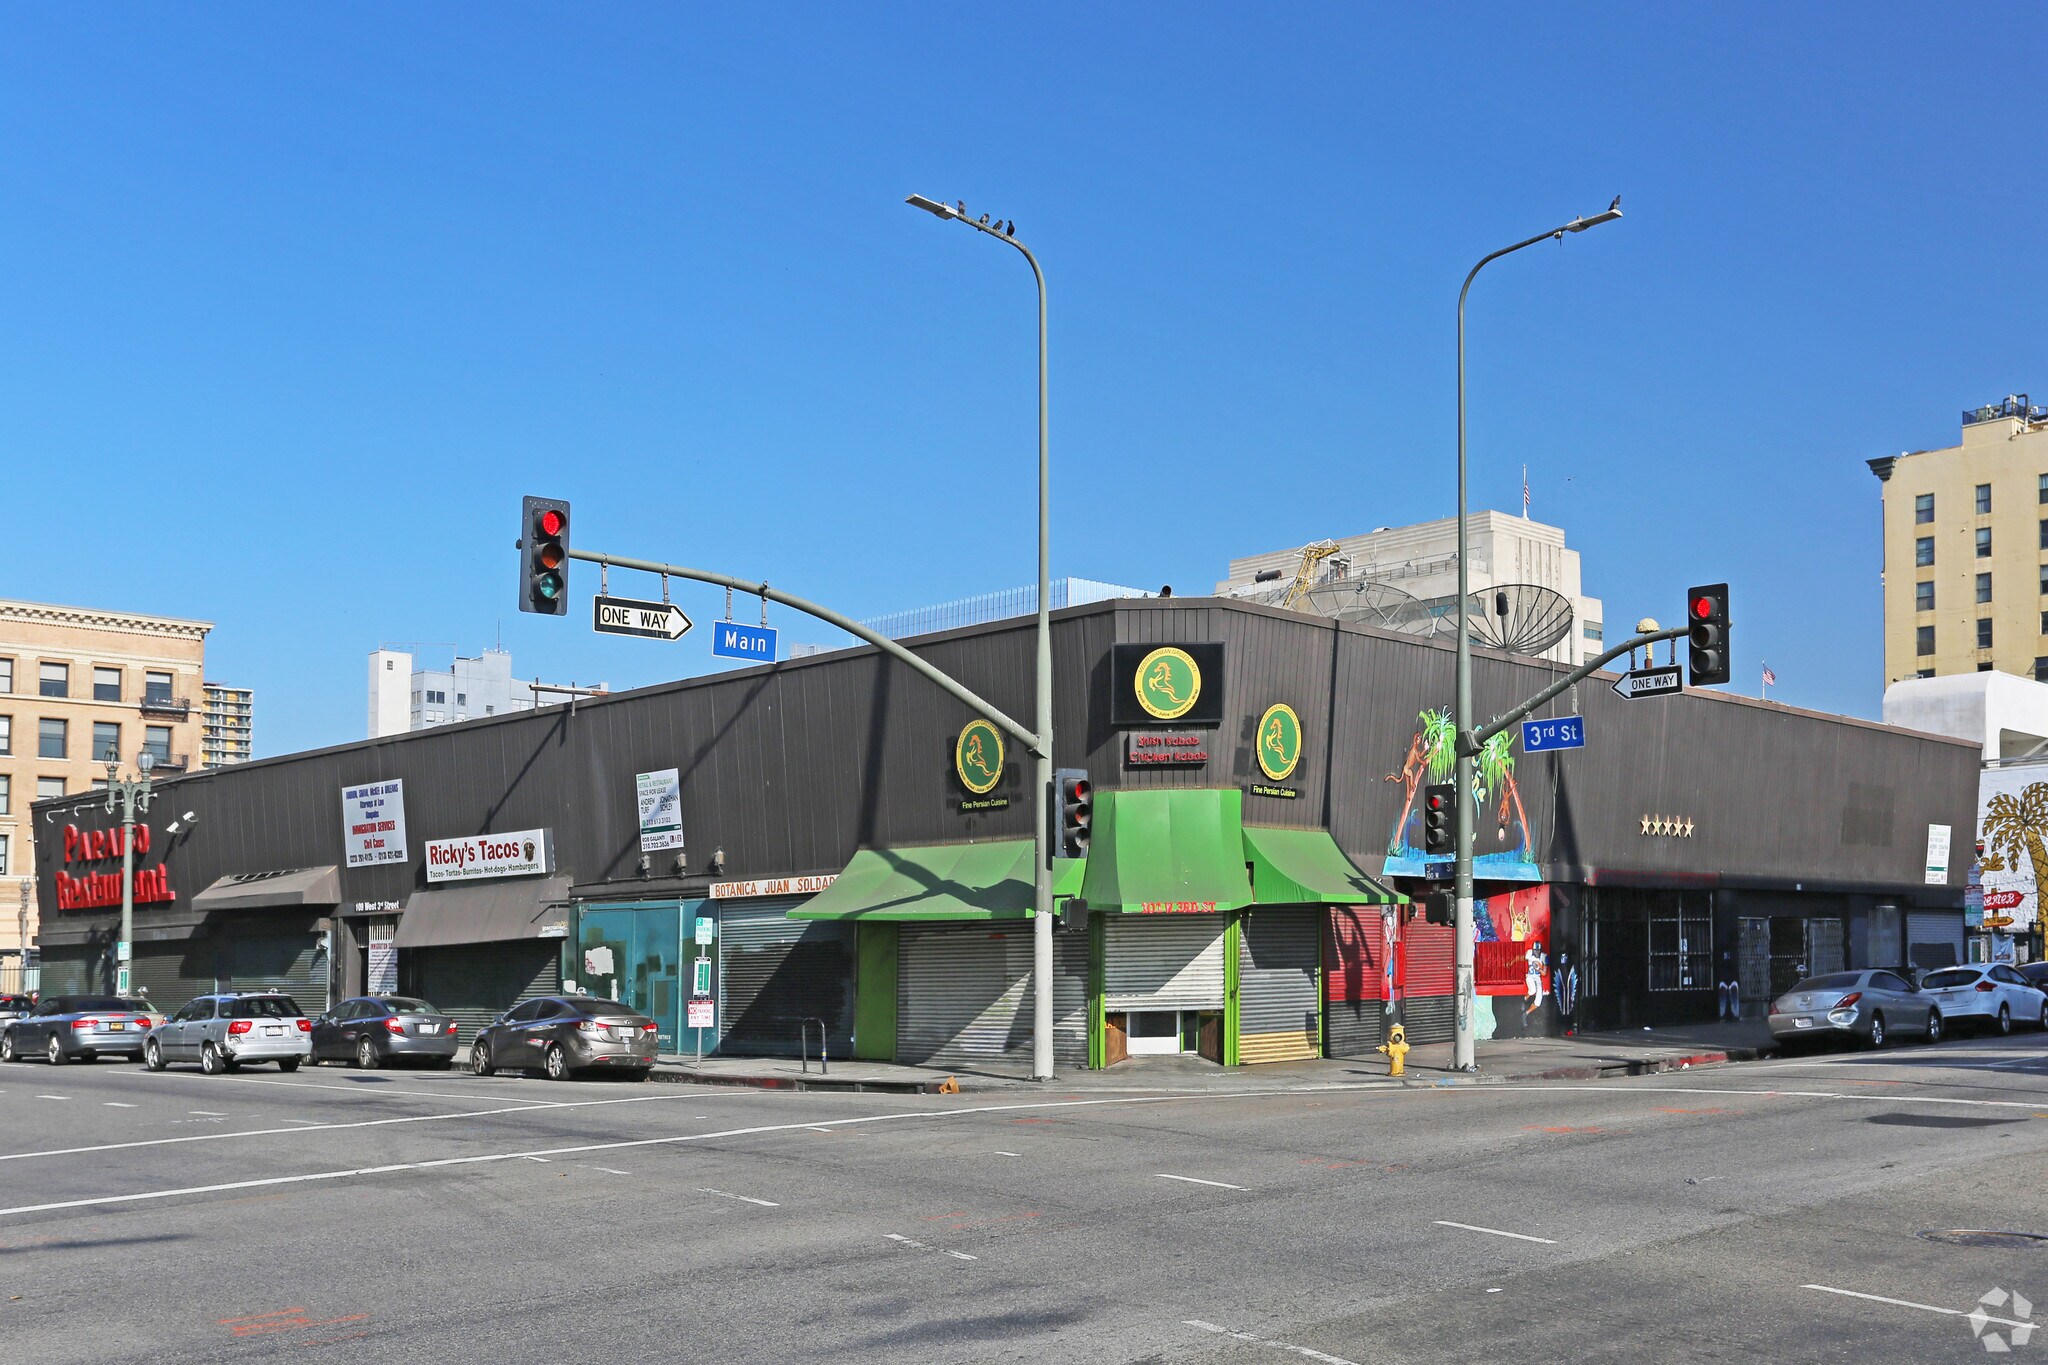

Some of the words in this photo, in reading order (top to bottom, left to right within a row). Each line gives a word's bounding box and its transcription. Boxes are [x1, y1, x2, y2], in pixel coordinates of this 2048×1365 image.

[602, 607, 630, 625] ONE
[640, 611, 670, 629] WAY
[725, 631, 766, 653] Main
[1632, 679, 1651, 690] ONE
[1655, 675, 1675, 687] WAY
[1137, 736, 1163, 747] Shish
[1530, 726, 1555, 746] 3rd
[1561, 725, 1577, 741] St
[1130, 751, 1170, 762] Chicken
[1253, 785, 1263, 794] Fine
[1263, 786, 1280, 796] Persian
[1280, 788, 1296, 798] Cuisine
[962, 801, 973, 810] Fine
[972, 800, 991, 809] Persian
[990, 798, 1008, 807] Cuisine
[430, 842, 475, 869] Ricky's
[478, 840, 520, 861] Tacos
[508, 862, 539, 872] Hamburgers
[715, 881, 758, 897] BOTANICA
[765, 880, 790, 894] JUAN
[355, 902, 364, 912] 109
[364, 901, 377, 911] West
[384, 900, 400, 910] Street
[1142, 901, 1163, 914] 101
[1165, 901, 1174, 914] W
[1176, 901, 1199, 913] 3RD
[1201, 901, 1217, 913] ST
